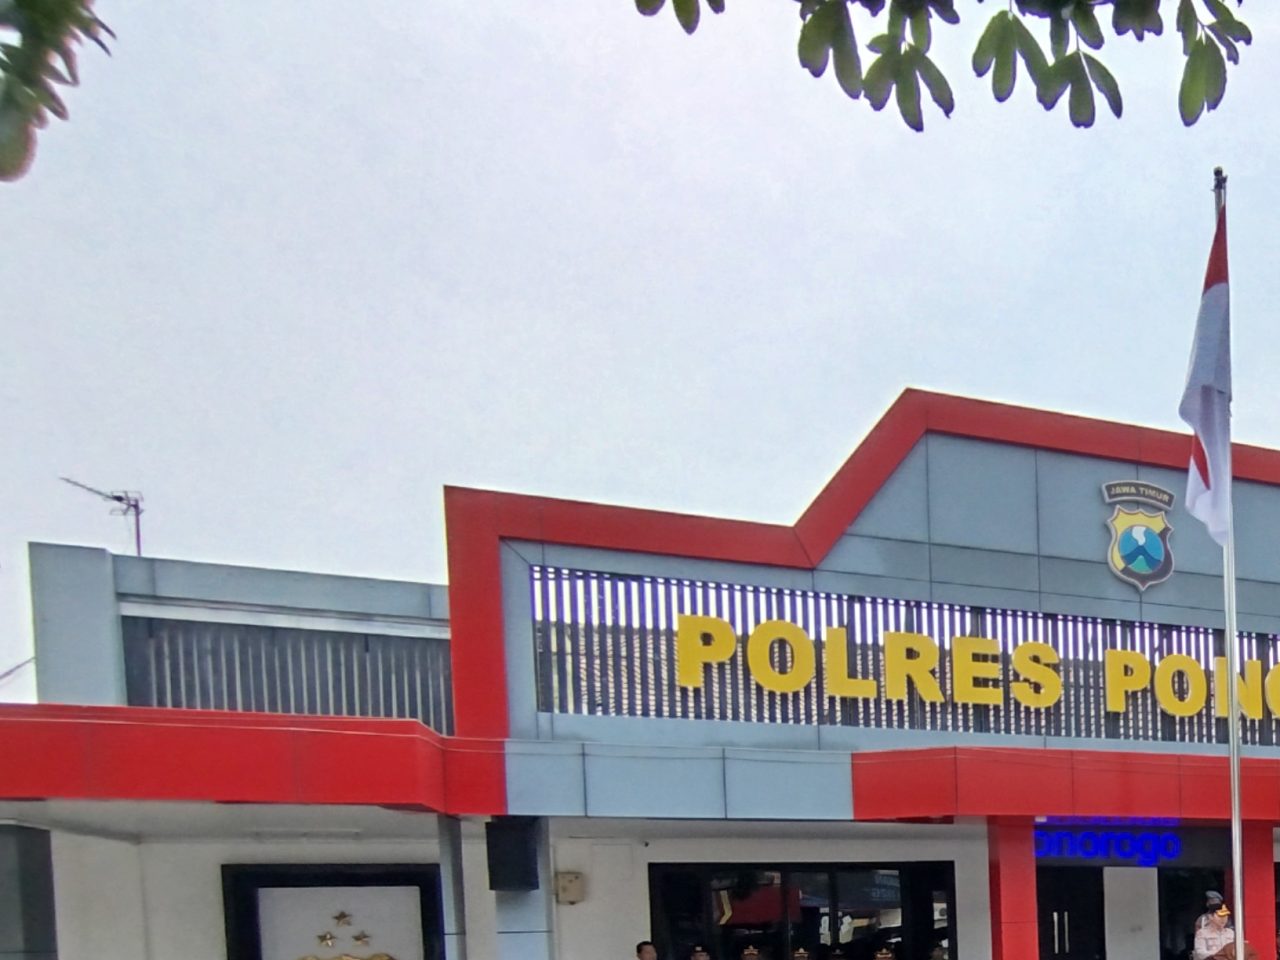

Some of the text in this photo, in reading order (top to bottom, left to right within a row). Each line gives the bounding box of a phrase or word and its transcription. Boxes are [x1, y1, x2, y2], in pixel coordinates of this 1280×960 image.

[1110, 486, 1169, 502] JAWA TIMUR
[677, 613, 1063, 709] POLRES
